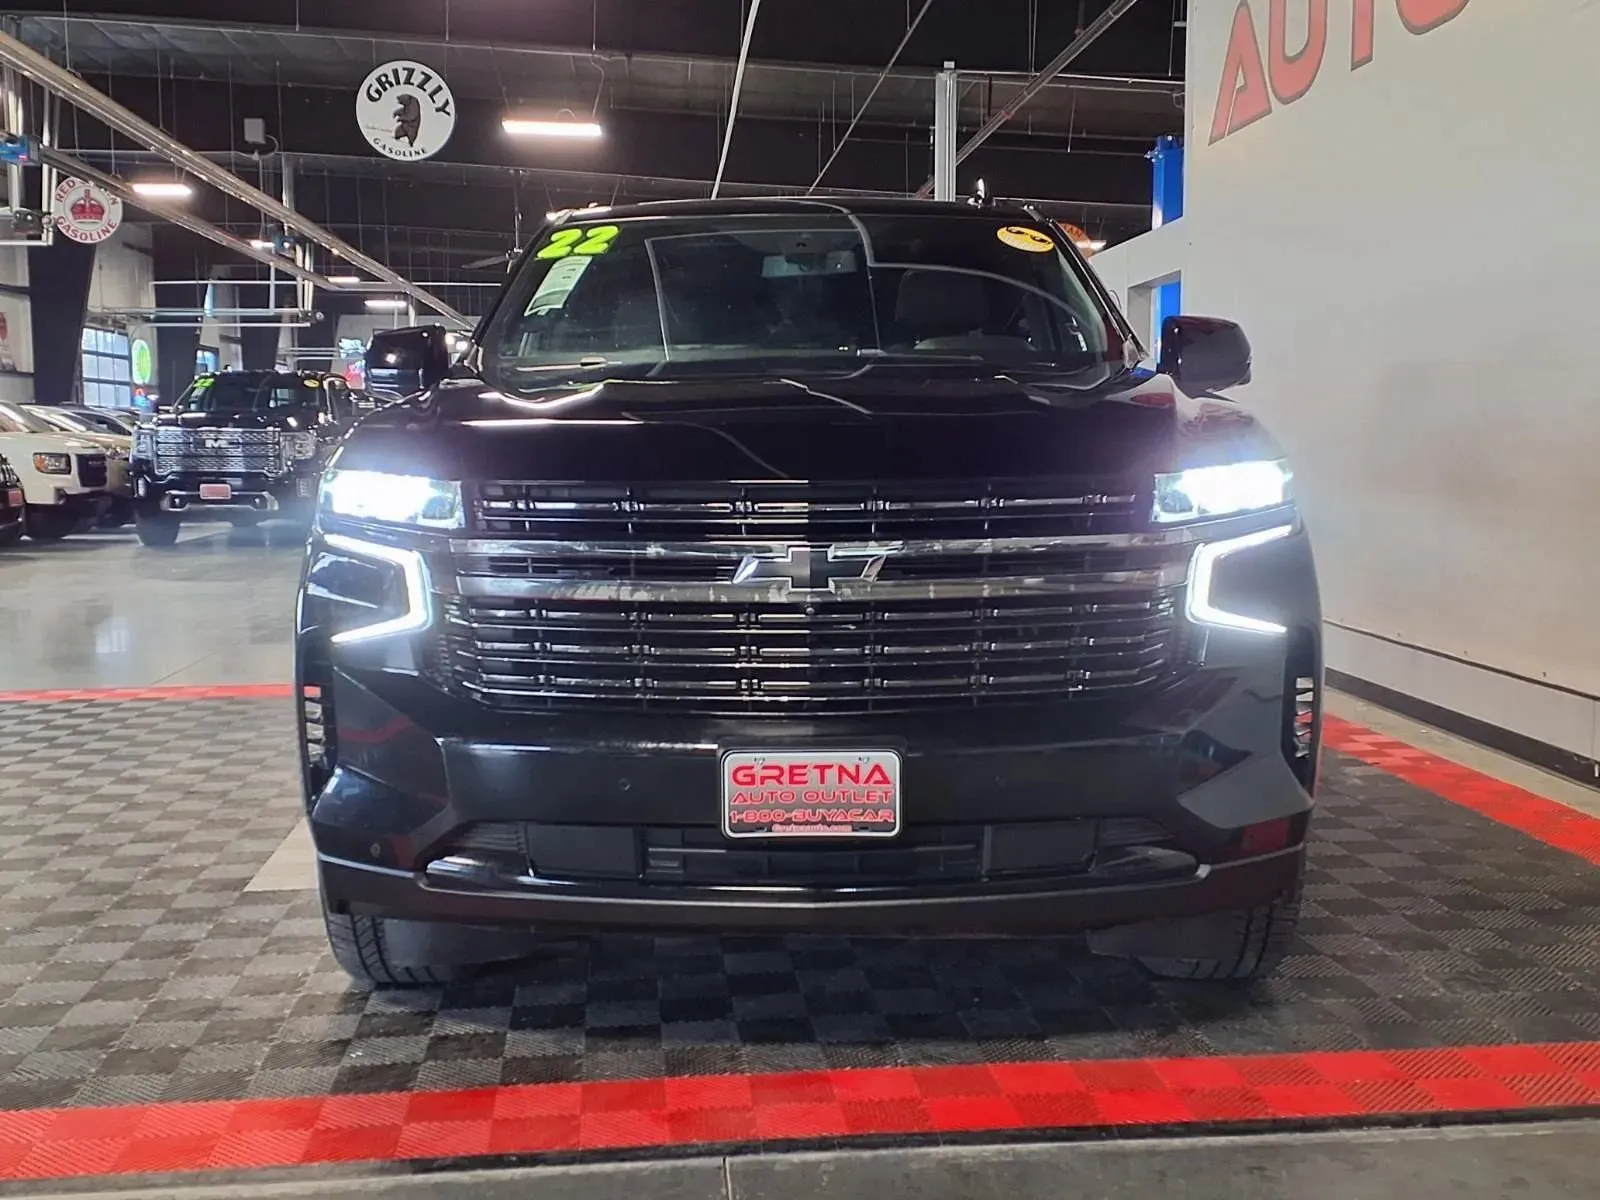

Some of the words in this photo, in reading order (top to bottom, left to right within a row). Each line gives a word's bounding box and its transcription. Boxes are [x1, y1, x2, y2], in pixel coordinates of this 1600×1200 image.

[1208, 0, 1471, 145] AU
[366, 67, 451, 117] GRIZZLY
[56, 180, 76, 203] RED
[56, 216, 117, 241] GASOLINE
[537, 225, 619, 259] 22
[731, 763, 892, 787] GRETNA
[731, 789, 796, 805] AUTO
[803, 788, 893, 804] OUTLET
[729, 808, 895, 823] 1-800-BUYACAR
